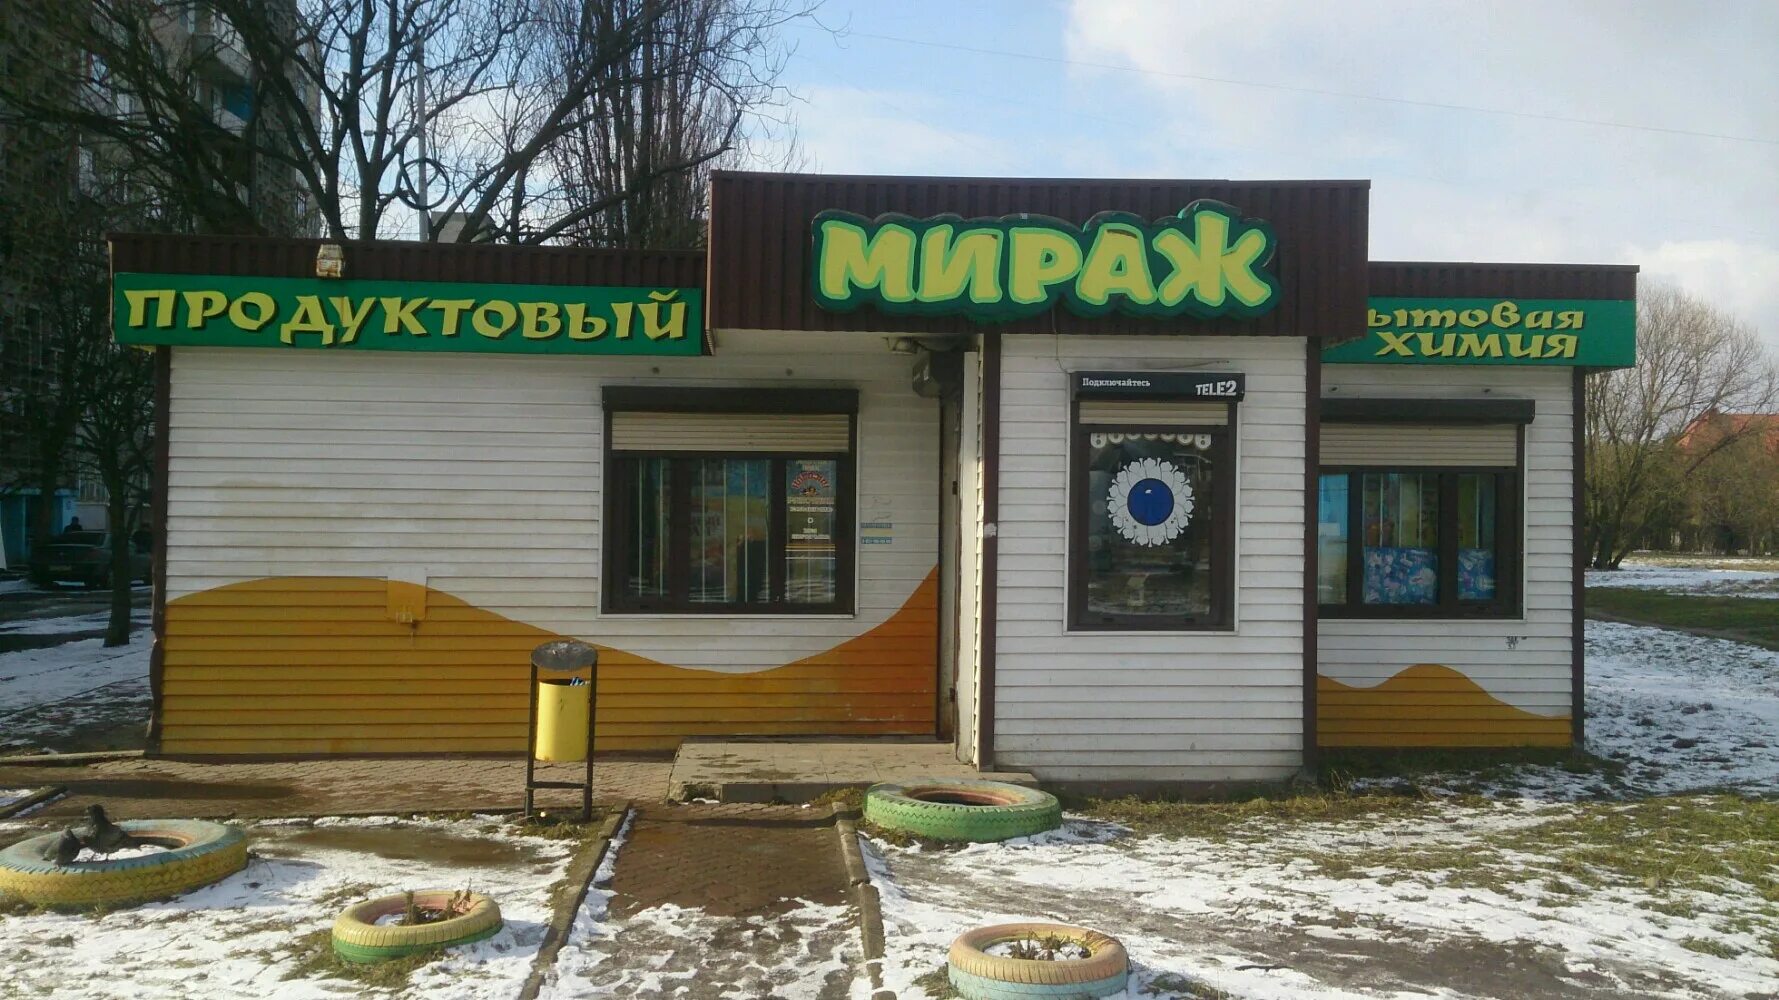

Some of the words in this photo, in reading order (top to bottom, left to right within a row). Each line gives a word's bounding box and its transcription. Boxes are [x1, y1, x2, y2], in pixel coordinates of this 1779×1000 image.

[818, 208, 1272, 308] МИРАЖ
[123, 288, 687, 346] ПРОДУКТОВЫЙ
[1367, 300, 1584, 329] ытовая
[1081, 377, 1151, 388] Подключайтесь
[1195, 379, 1237, 397] TELE2
